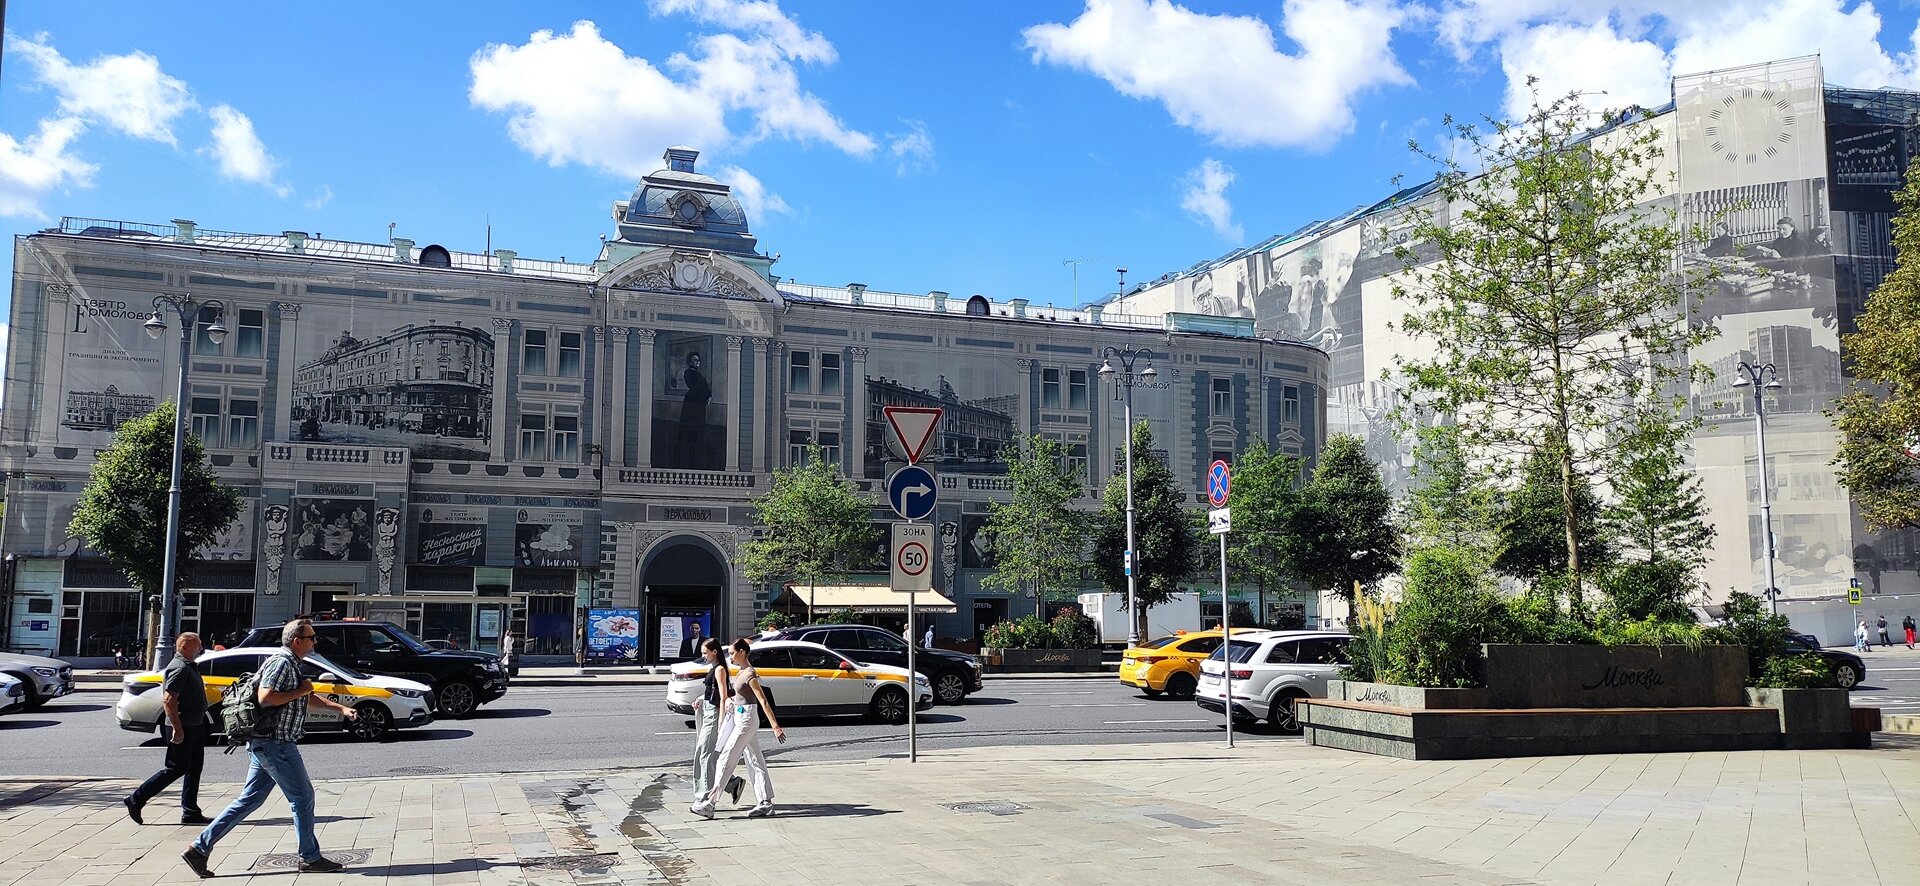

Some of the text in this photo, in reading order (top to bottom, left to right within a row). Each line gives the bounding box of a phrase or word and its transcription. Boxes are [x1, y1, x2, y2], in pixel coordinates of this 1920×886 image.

[903, 527, 927, 537] ЗОНА
[905, 552, 923, 566] 50
[1035, 652, 1071, 662] Москва
[1581, 666, 1665, 690] Москва
